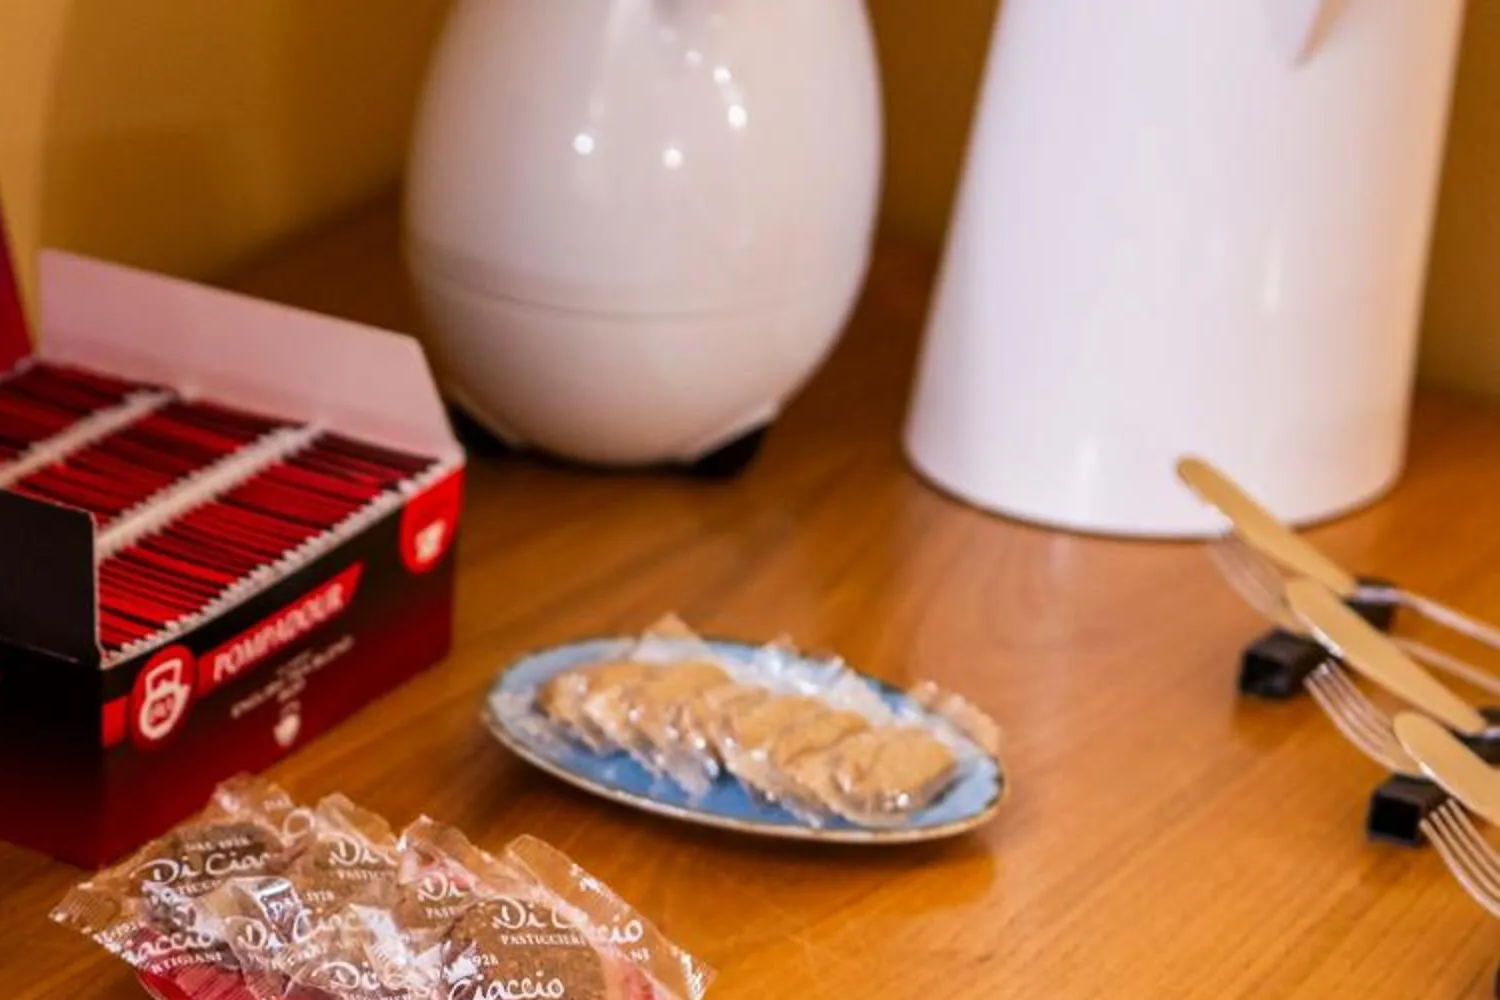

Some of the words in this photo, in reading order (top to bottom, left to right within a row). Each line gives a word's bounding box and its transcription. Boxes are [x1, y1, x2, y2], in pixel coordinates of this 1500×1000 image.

[213, 582, 344, 682] POMPADOUR
[128, 855, 200, 886] Di
[490, 895, 547, 930] Di
